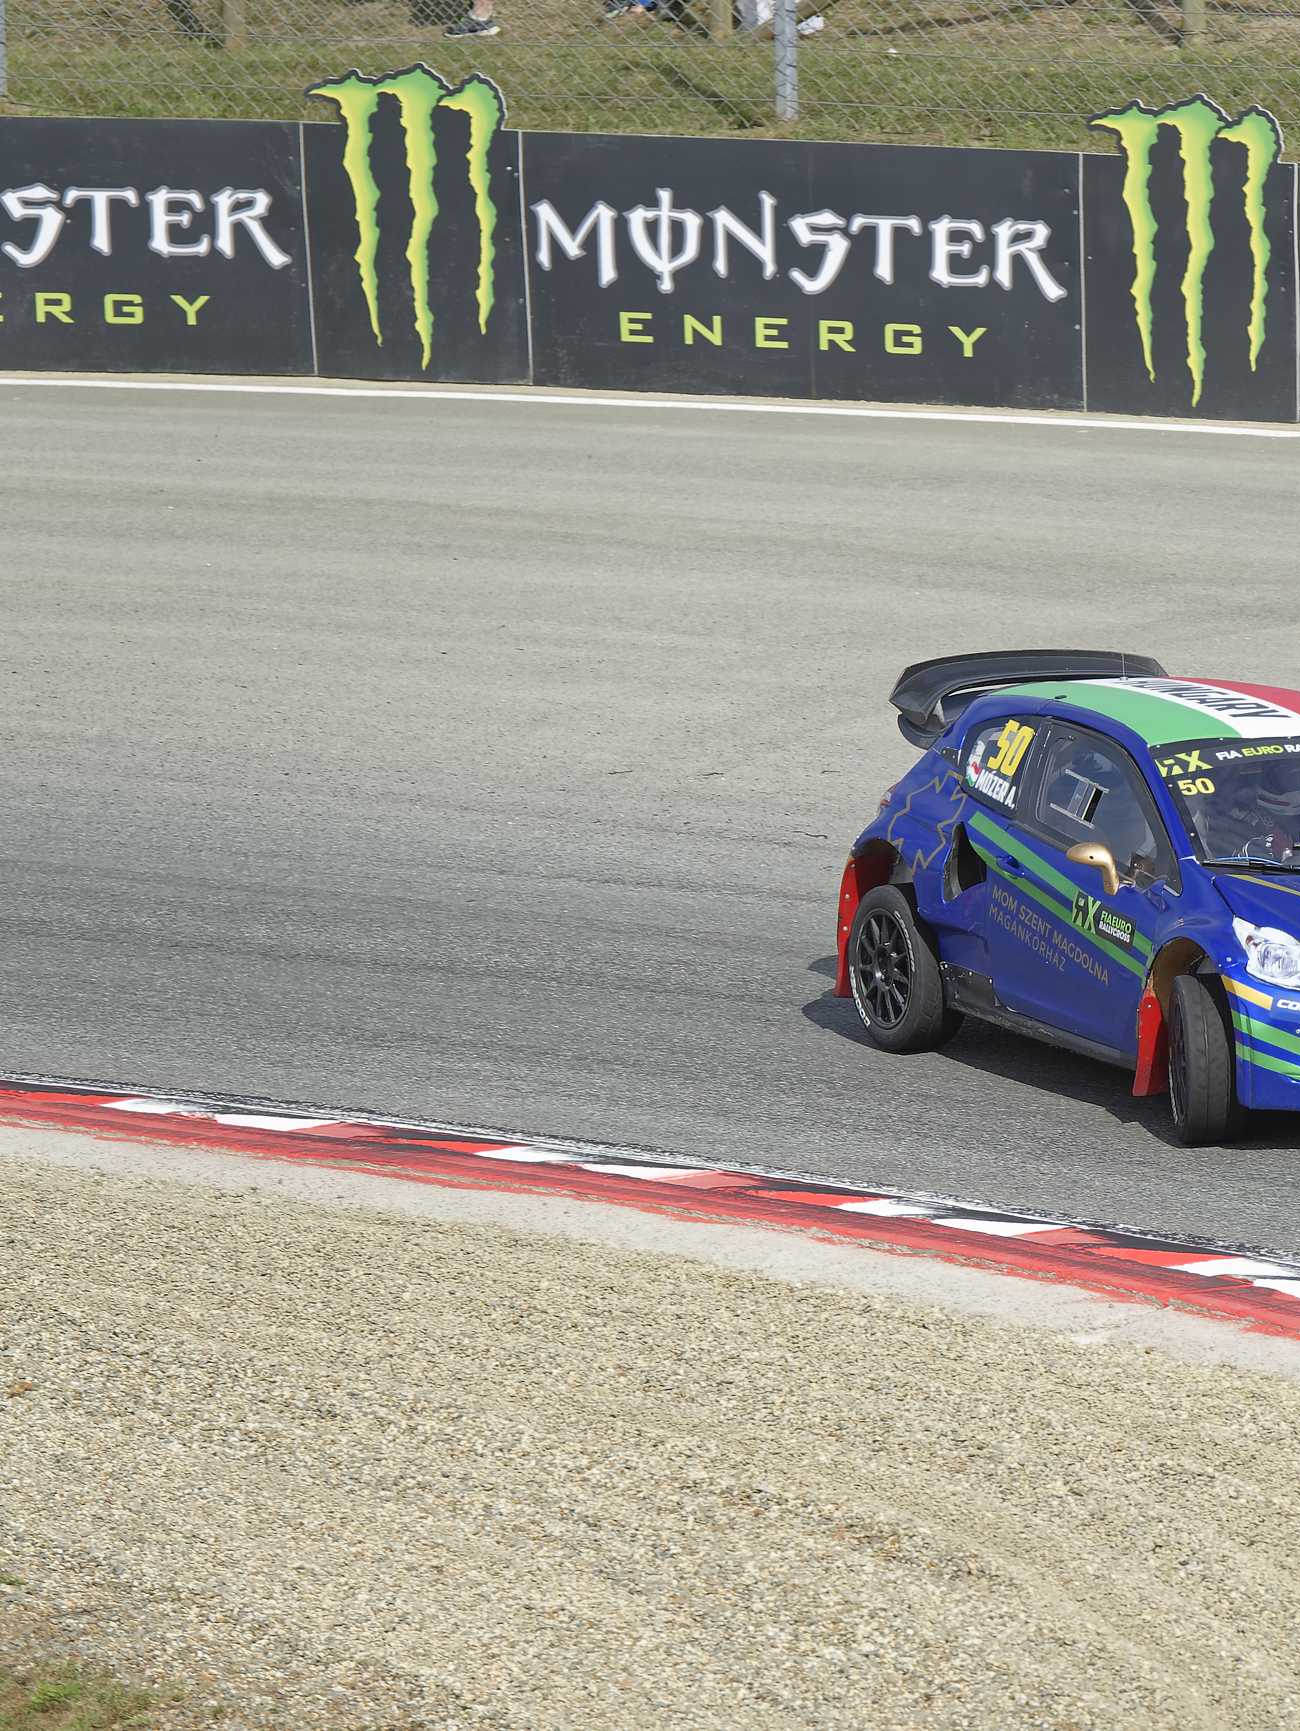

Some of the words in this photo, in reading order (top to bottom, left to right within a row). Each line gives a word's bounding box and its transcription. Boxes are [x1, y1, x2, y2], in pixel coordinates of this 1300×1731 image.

[530, 187, 1068, 303] MONSTER
[0, 291, 211, 326] RGY
[619, 311, 989, 357] ENERGY
[987, 719, 1035, 777] 50
[1216, 751, 1243, 760] FIA
[1241, 745, 1284, 757] EURO
[1177, 777, 1216, 796] 50
[1019, 906, 1052, 938] SZENT
[1052, 929, 1109, 985] MAGDOLNA
